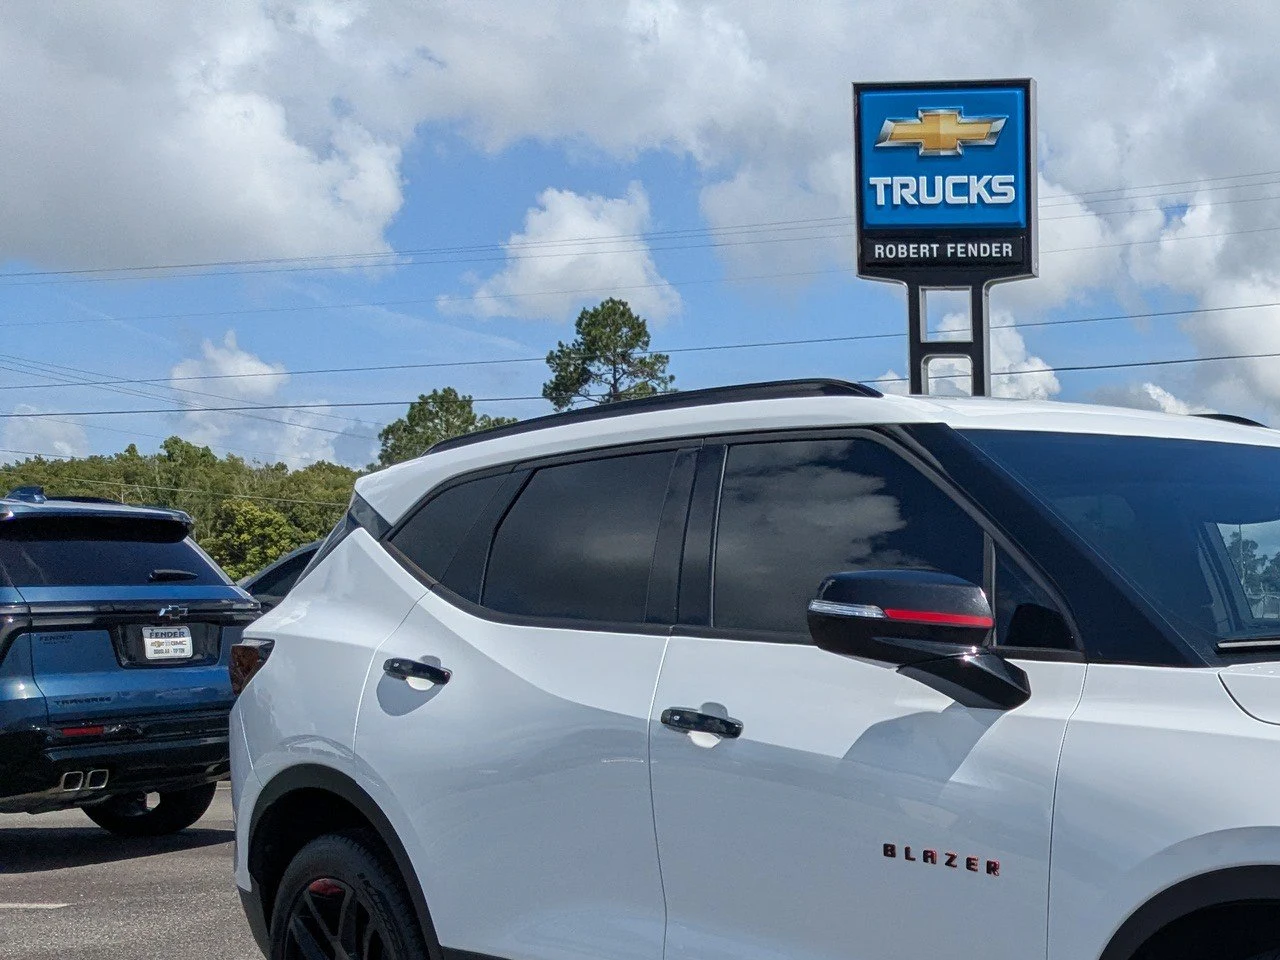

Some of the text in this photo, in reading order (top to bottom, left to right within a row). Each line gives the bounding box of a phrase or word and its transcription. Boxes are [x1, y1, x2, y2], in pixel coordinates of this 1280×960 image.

[869, 175, 1016, 206] TRUCKS
[874, 243, 1013, 259] ROBERT FENDER
[882, 843, 1000, 876] BLAZER
